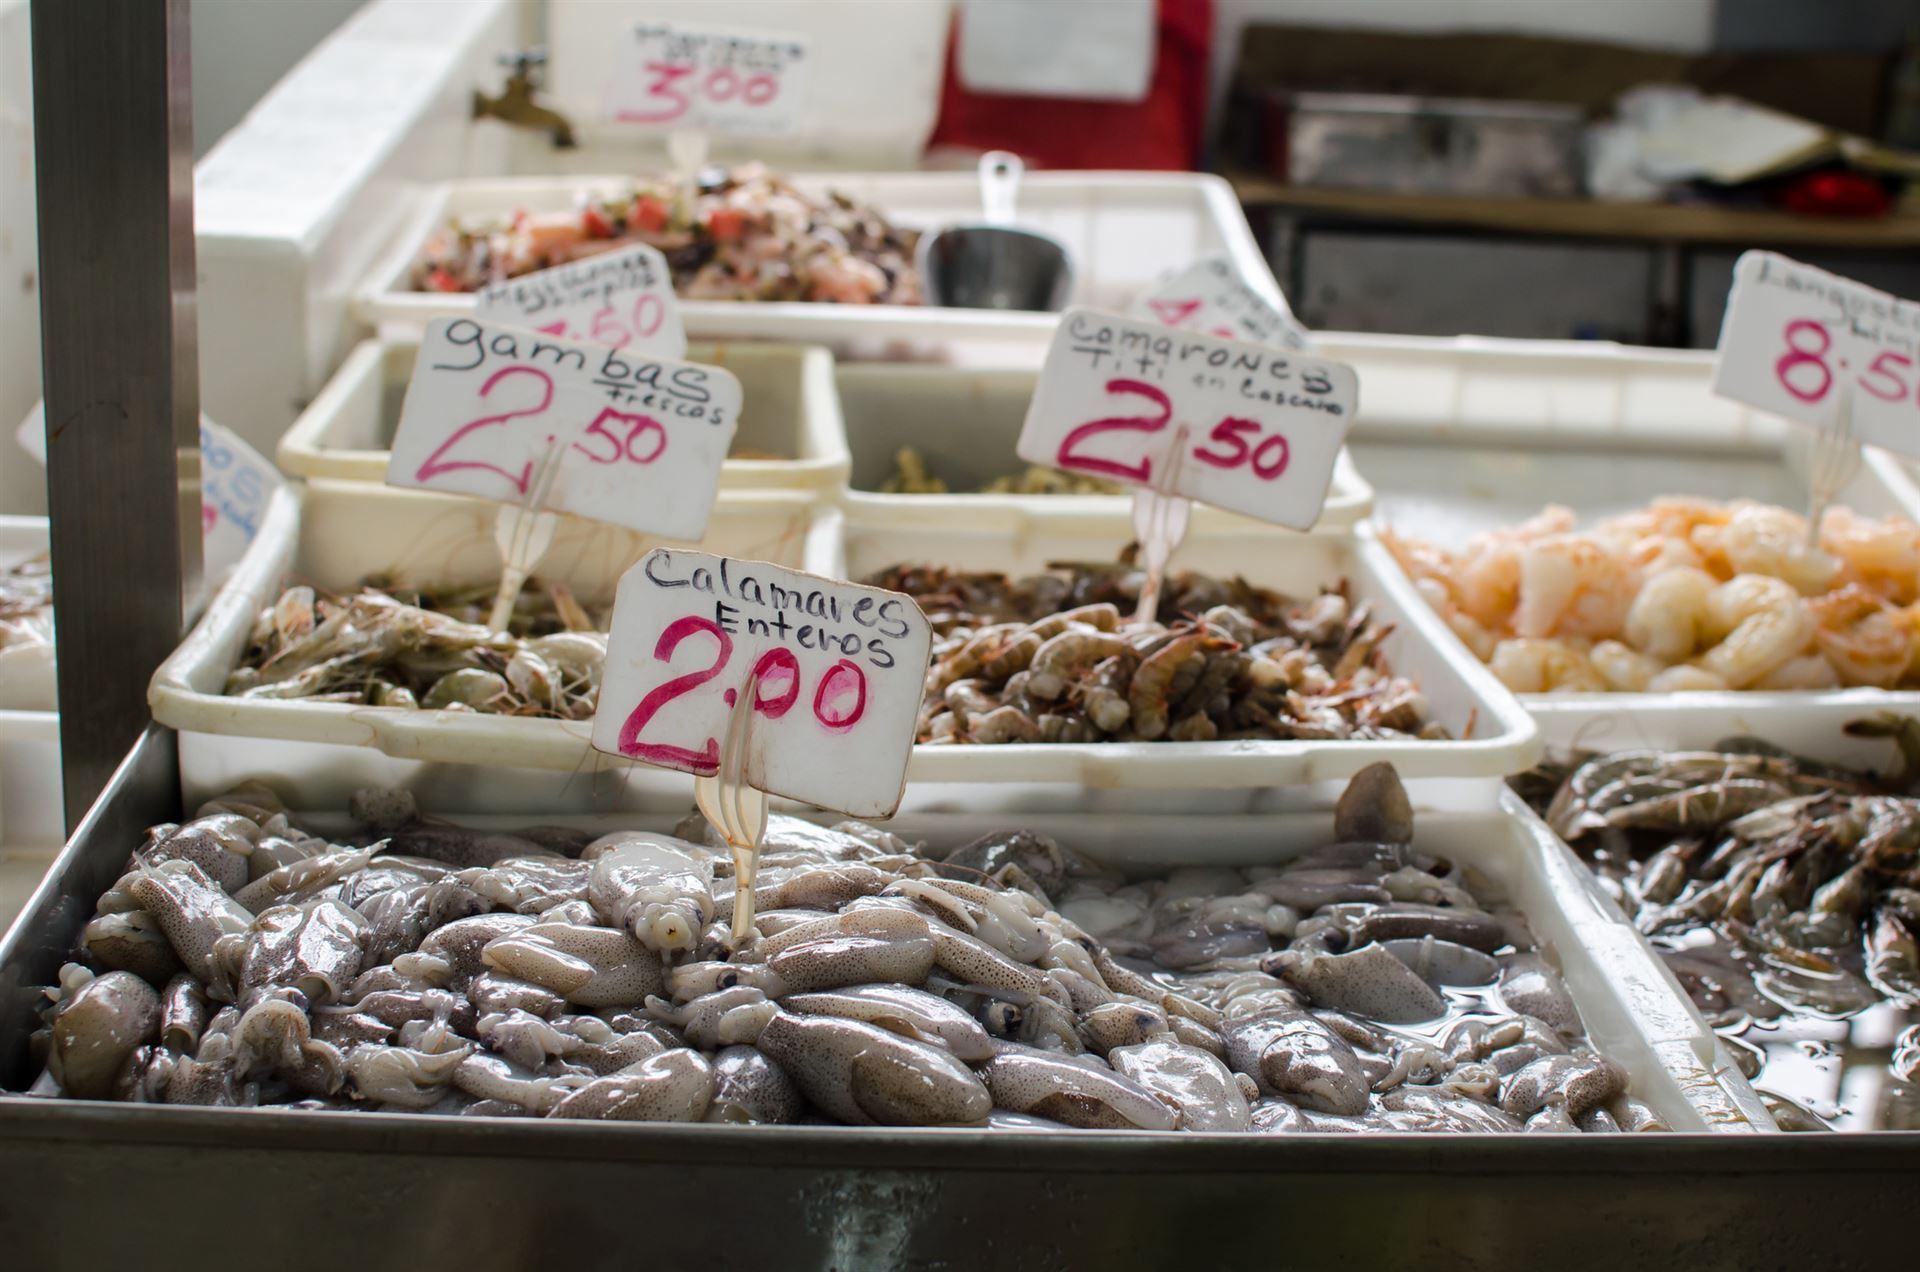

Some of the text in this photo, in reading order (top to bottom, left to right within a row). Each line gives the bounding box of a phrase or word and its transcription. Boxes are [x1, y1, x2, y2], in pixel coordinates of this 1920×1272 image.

[1775, 319, 1920, 413] 8.5
[645, 551, 910, 639] Calamares
[716, 601, 895, 668] Enteros
[618, 615, 867, 771] 2.00
